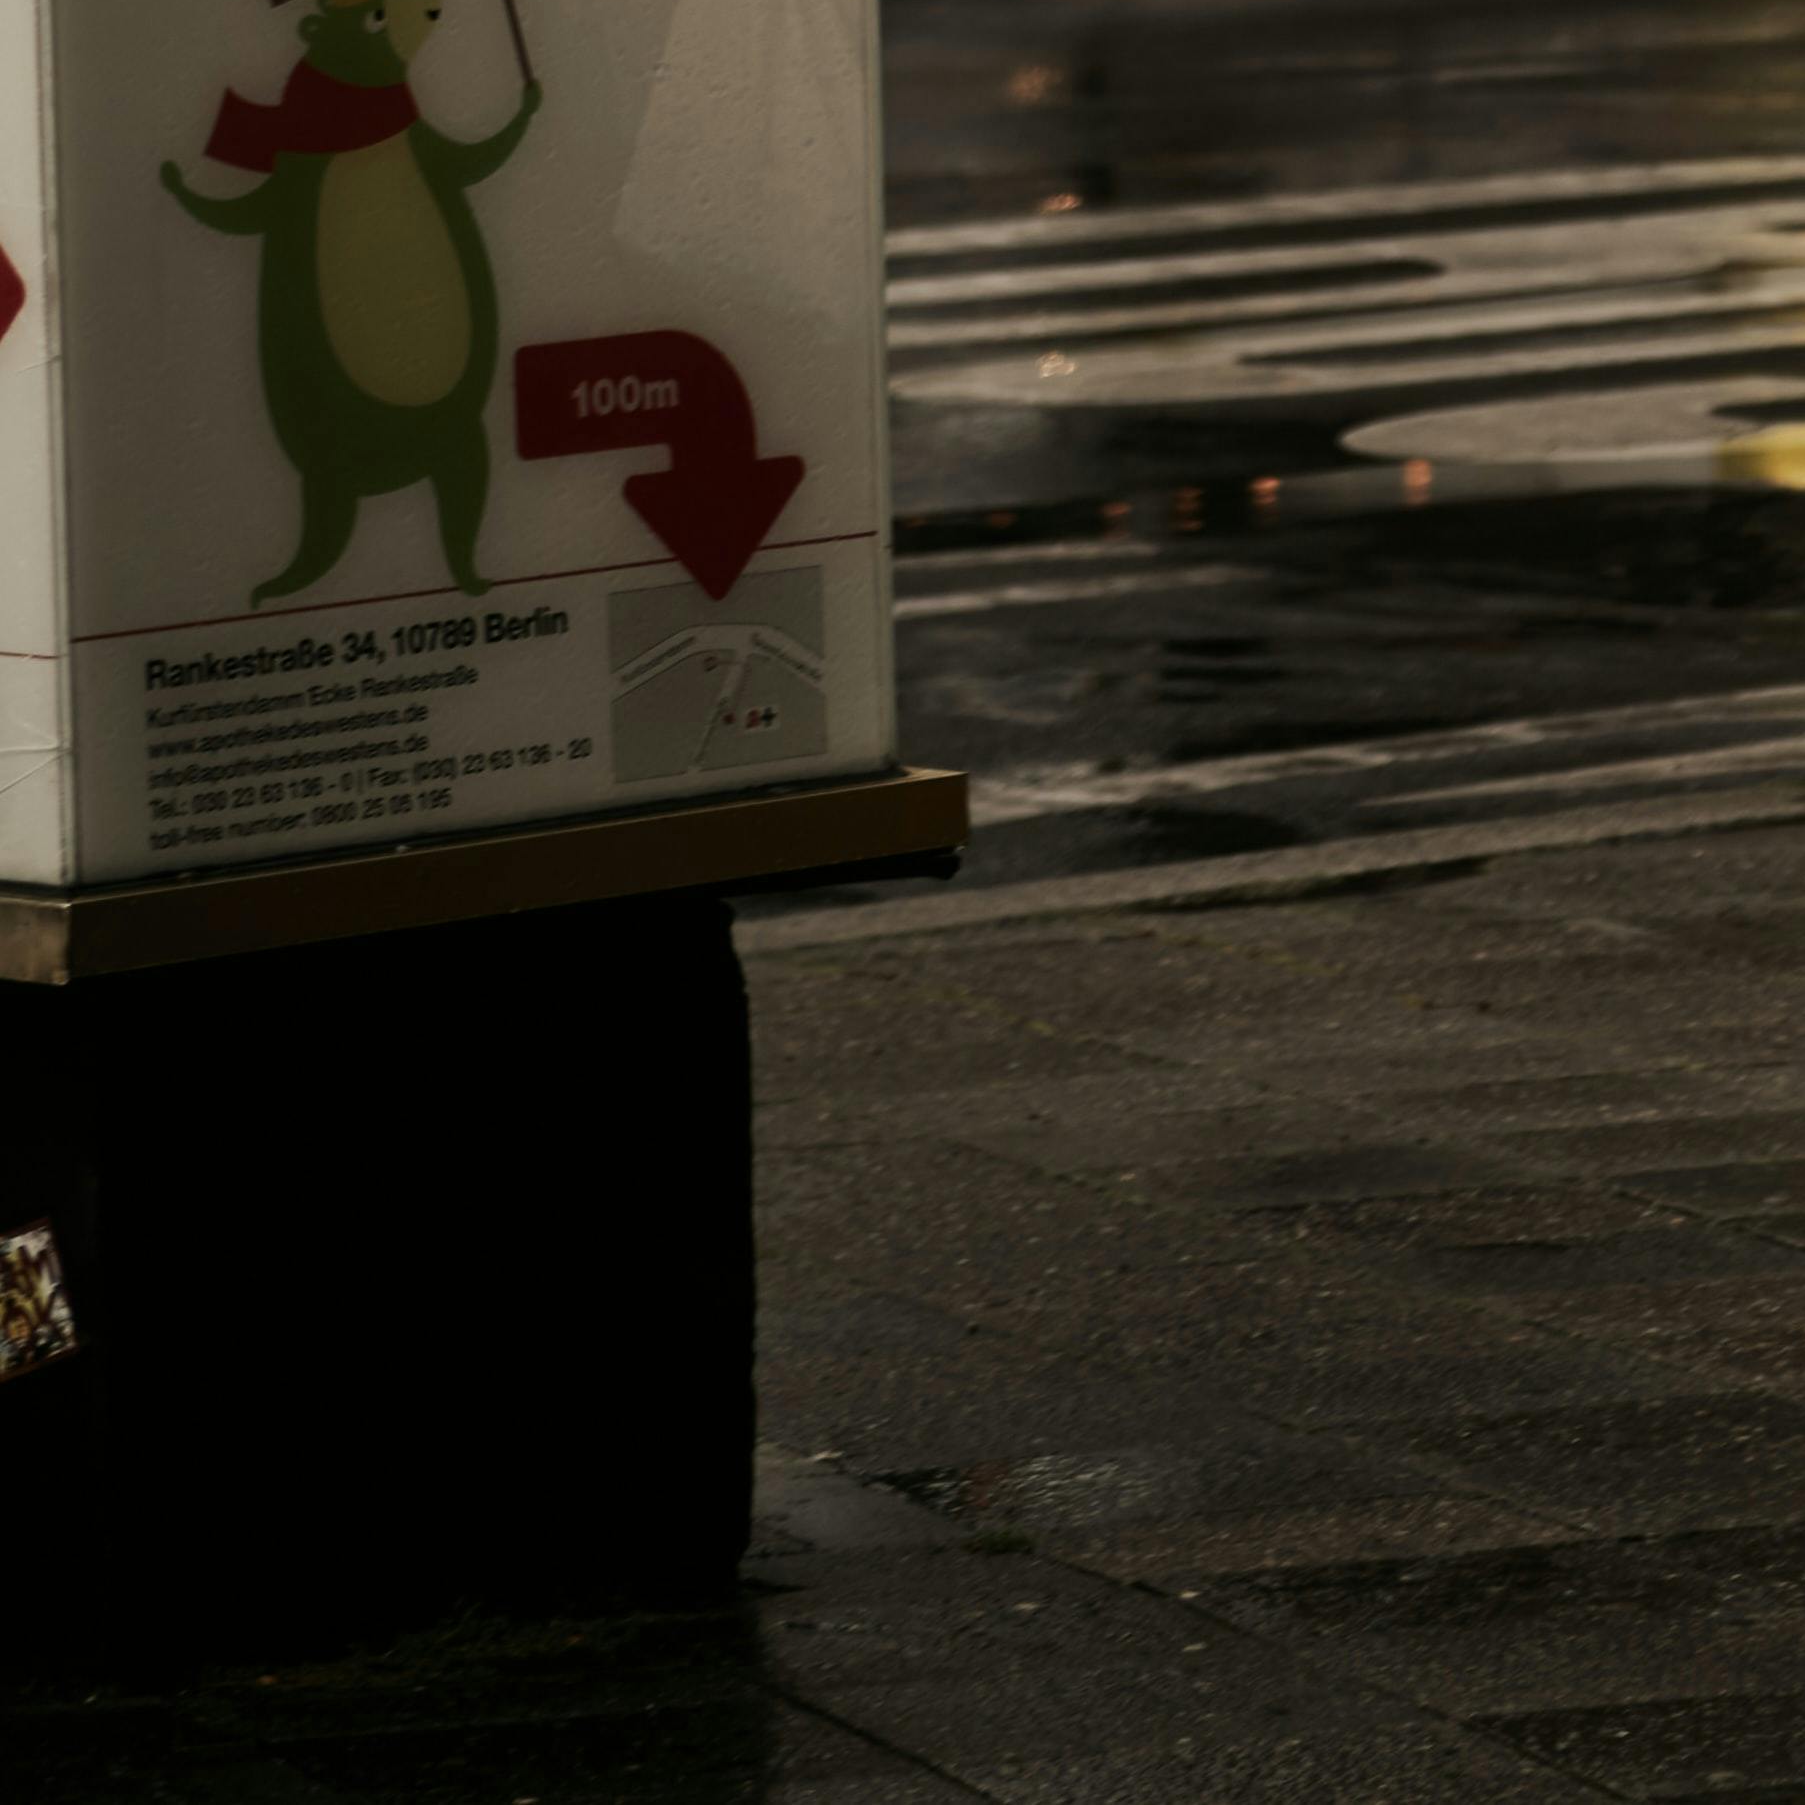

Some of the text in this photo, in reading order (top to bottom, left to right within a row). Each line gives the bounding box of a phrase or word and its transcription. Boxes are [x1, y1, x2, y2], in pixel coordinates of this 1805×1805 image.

[570, 373, 681, 420] 100m
[146, 606, 569, 691] Rankestraße 34, 10789 Berlin
